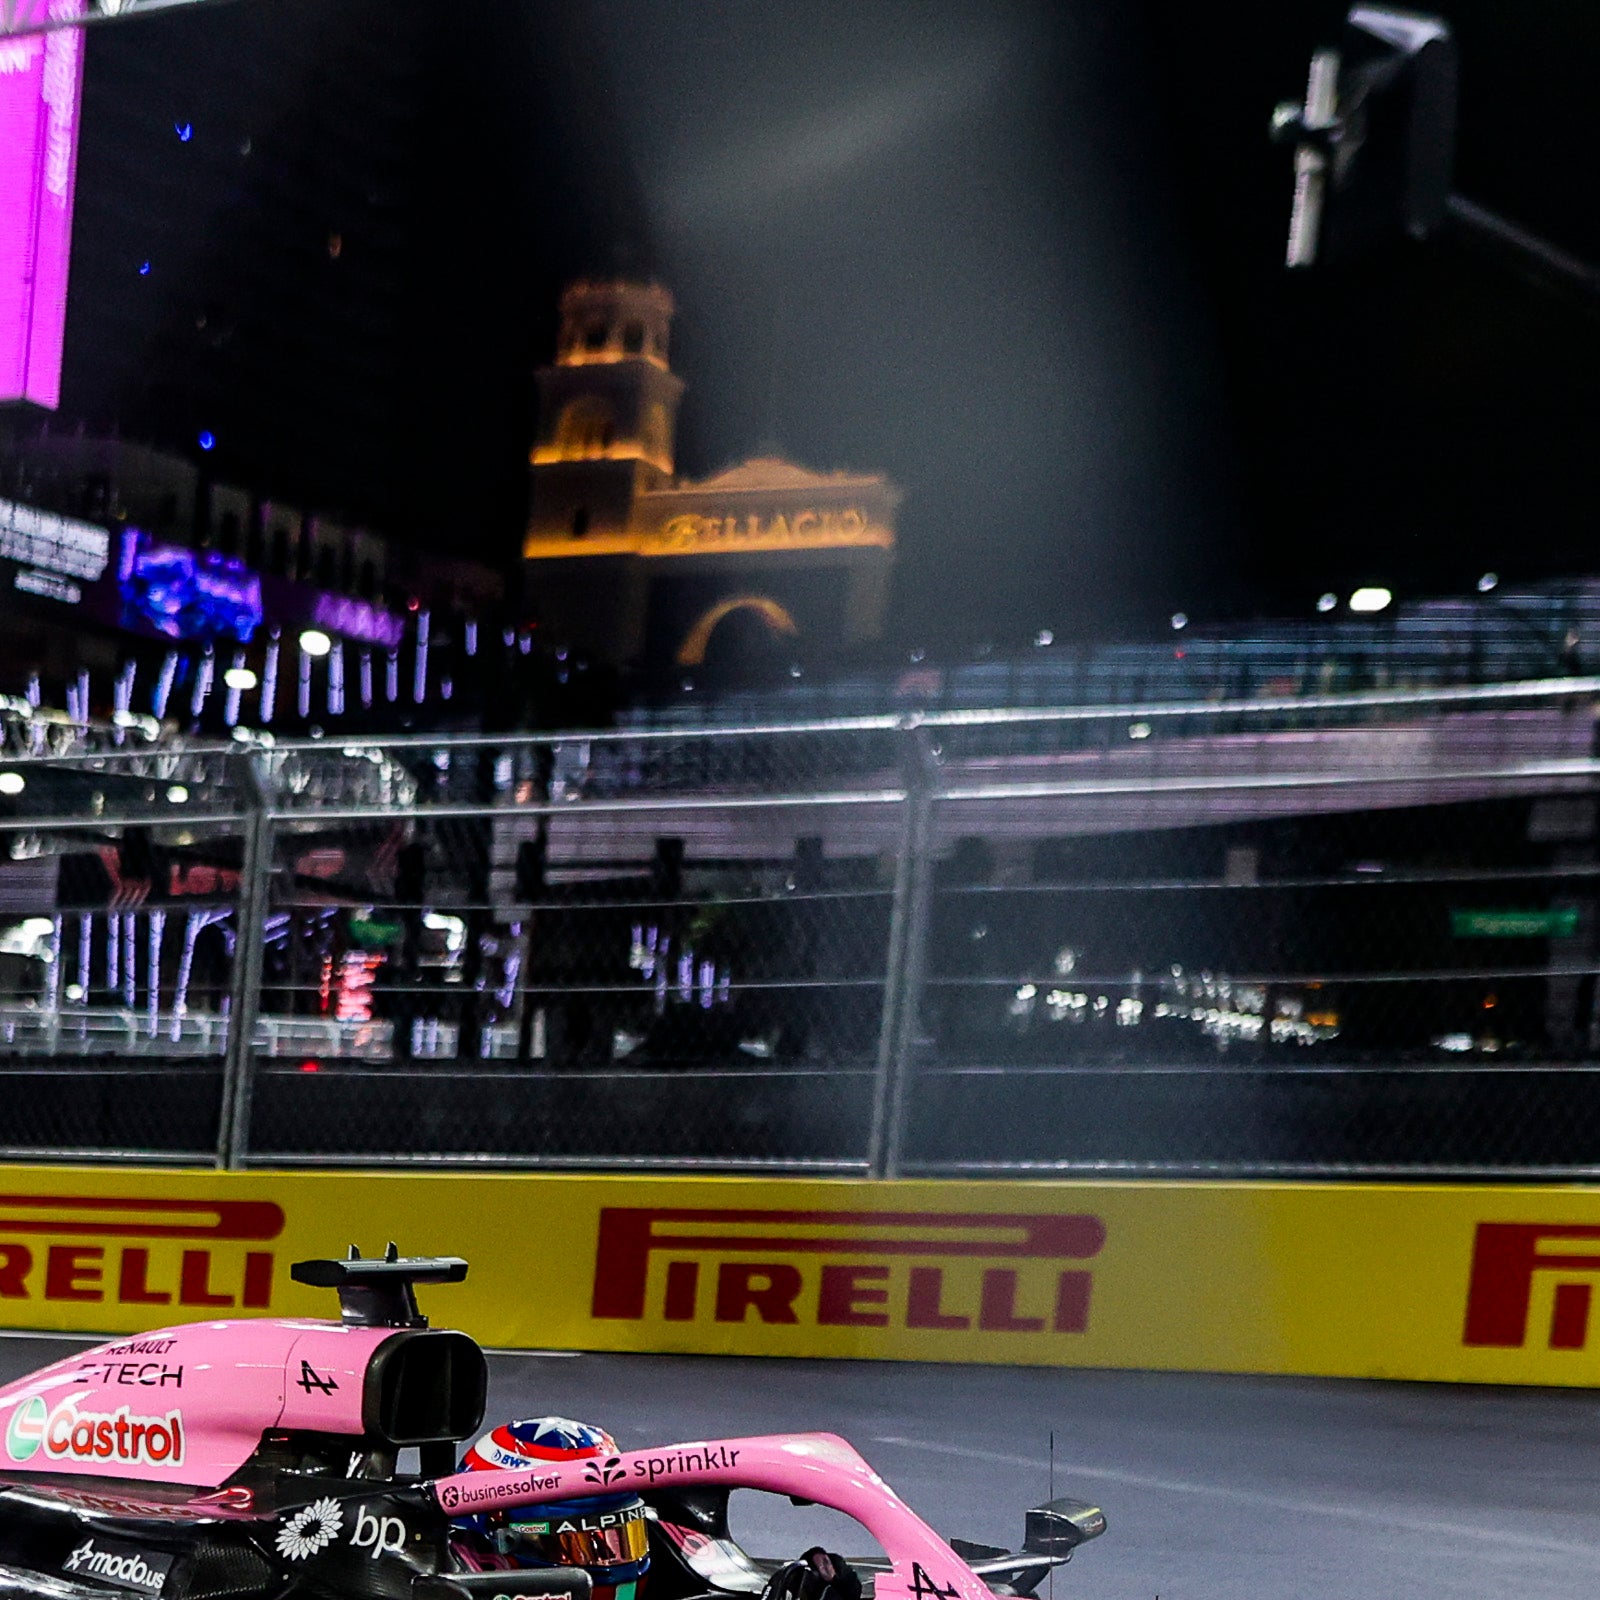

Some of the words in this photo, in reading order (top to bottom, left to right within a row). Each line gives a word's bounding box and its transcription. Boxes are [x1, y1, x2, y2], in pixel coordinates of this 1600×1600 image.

[591, 1206, 1106, 1336] PIRELLI
[105, 1340, 178, 1356] RENAULT
[73, 1363, 184, 1388] E-TECH
[47, 1405, 181, 1462] Castrol
[501, 1454, 532, 1469] BWT
[633, 1446, 742, 1484] sprinklr
[461, 1474, 563, 1504] businessolver
[349, 1511, 406, 1561] bp
[556, 1506, 648, 1534] ALPINE
[89, 1550, 165, 1590] modo.us
